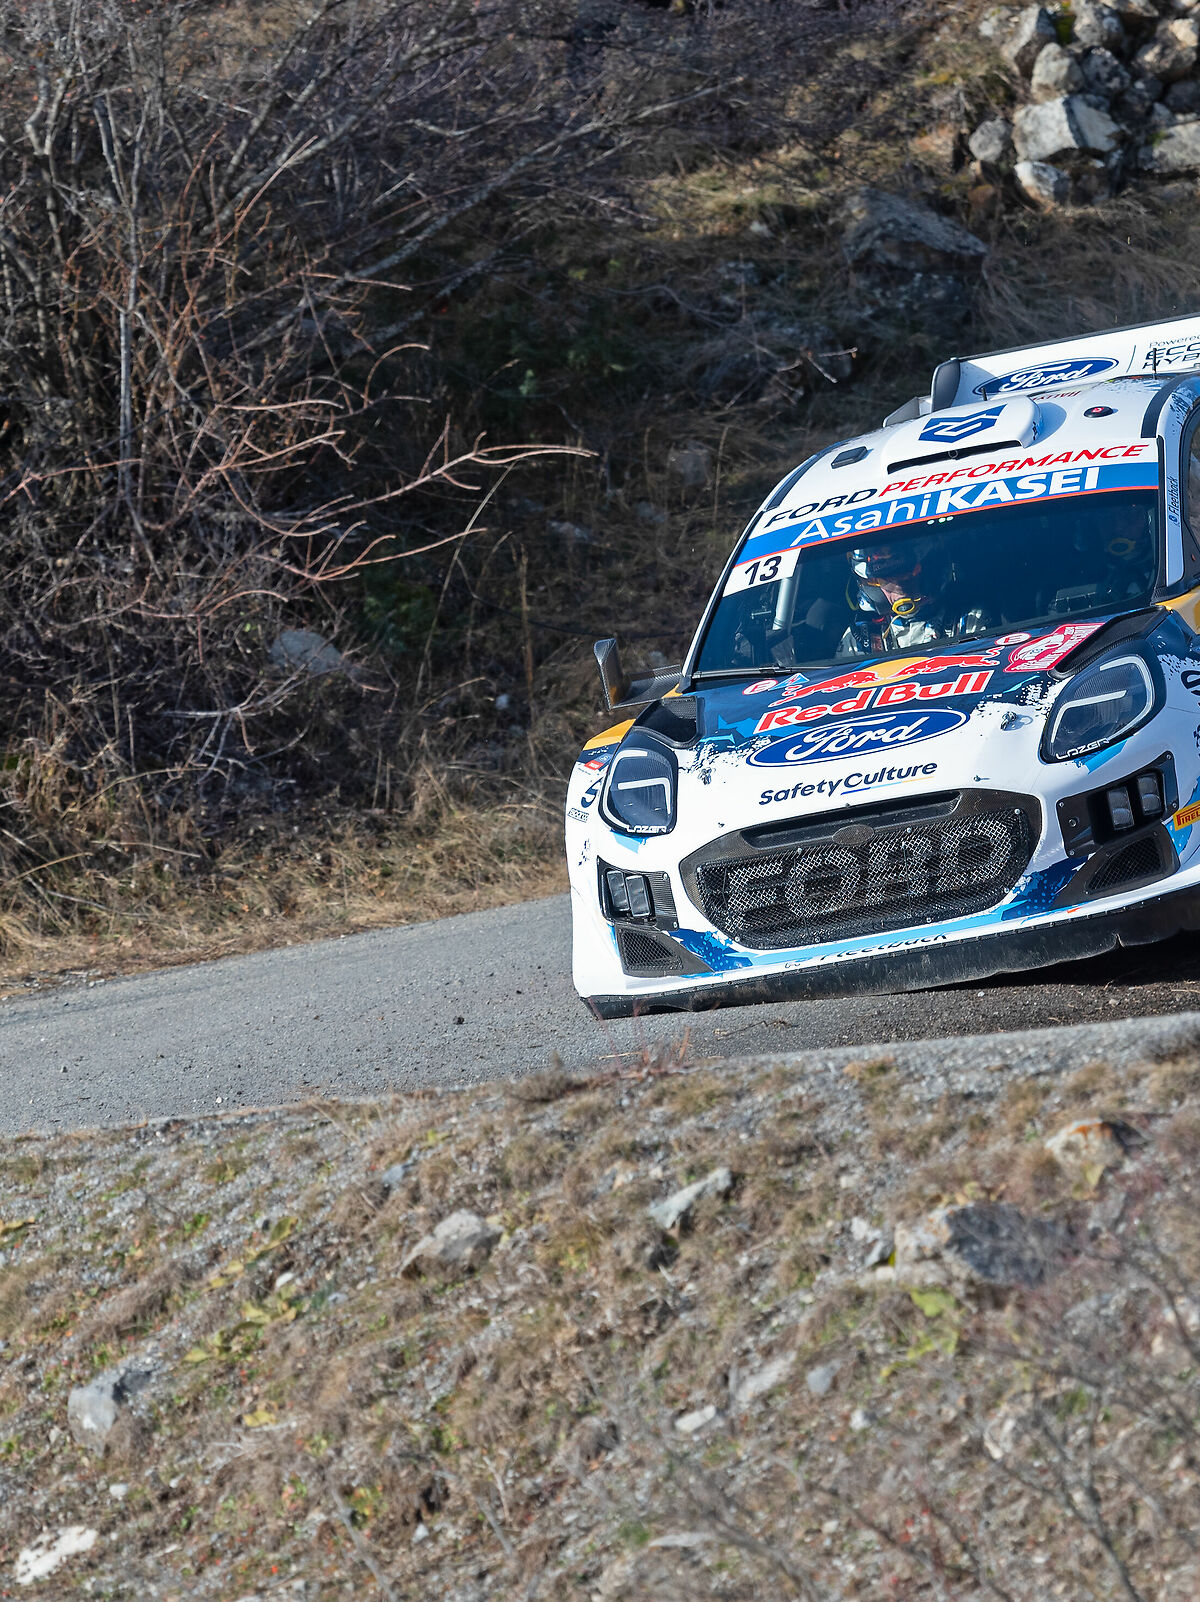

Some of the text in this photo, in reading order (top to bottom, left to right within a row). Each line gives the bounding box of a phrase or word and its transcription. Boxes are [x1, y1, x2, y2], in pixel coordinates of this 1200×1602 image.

[999, 362, 1094, 393] Ford
[878, 444, 1150, 498] PERFORMANCE
[789, 465, 1100, 547] AsahiKASEI
[744, 555, 782, 586] 13
[753, 670, 995, 735] Red Bull
[784, 715, 931, 762] Ford
[758, 762, 938, 806] SafetyCulture
[723, 817, 1013, 934] FORD
